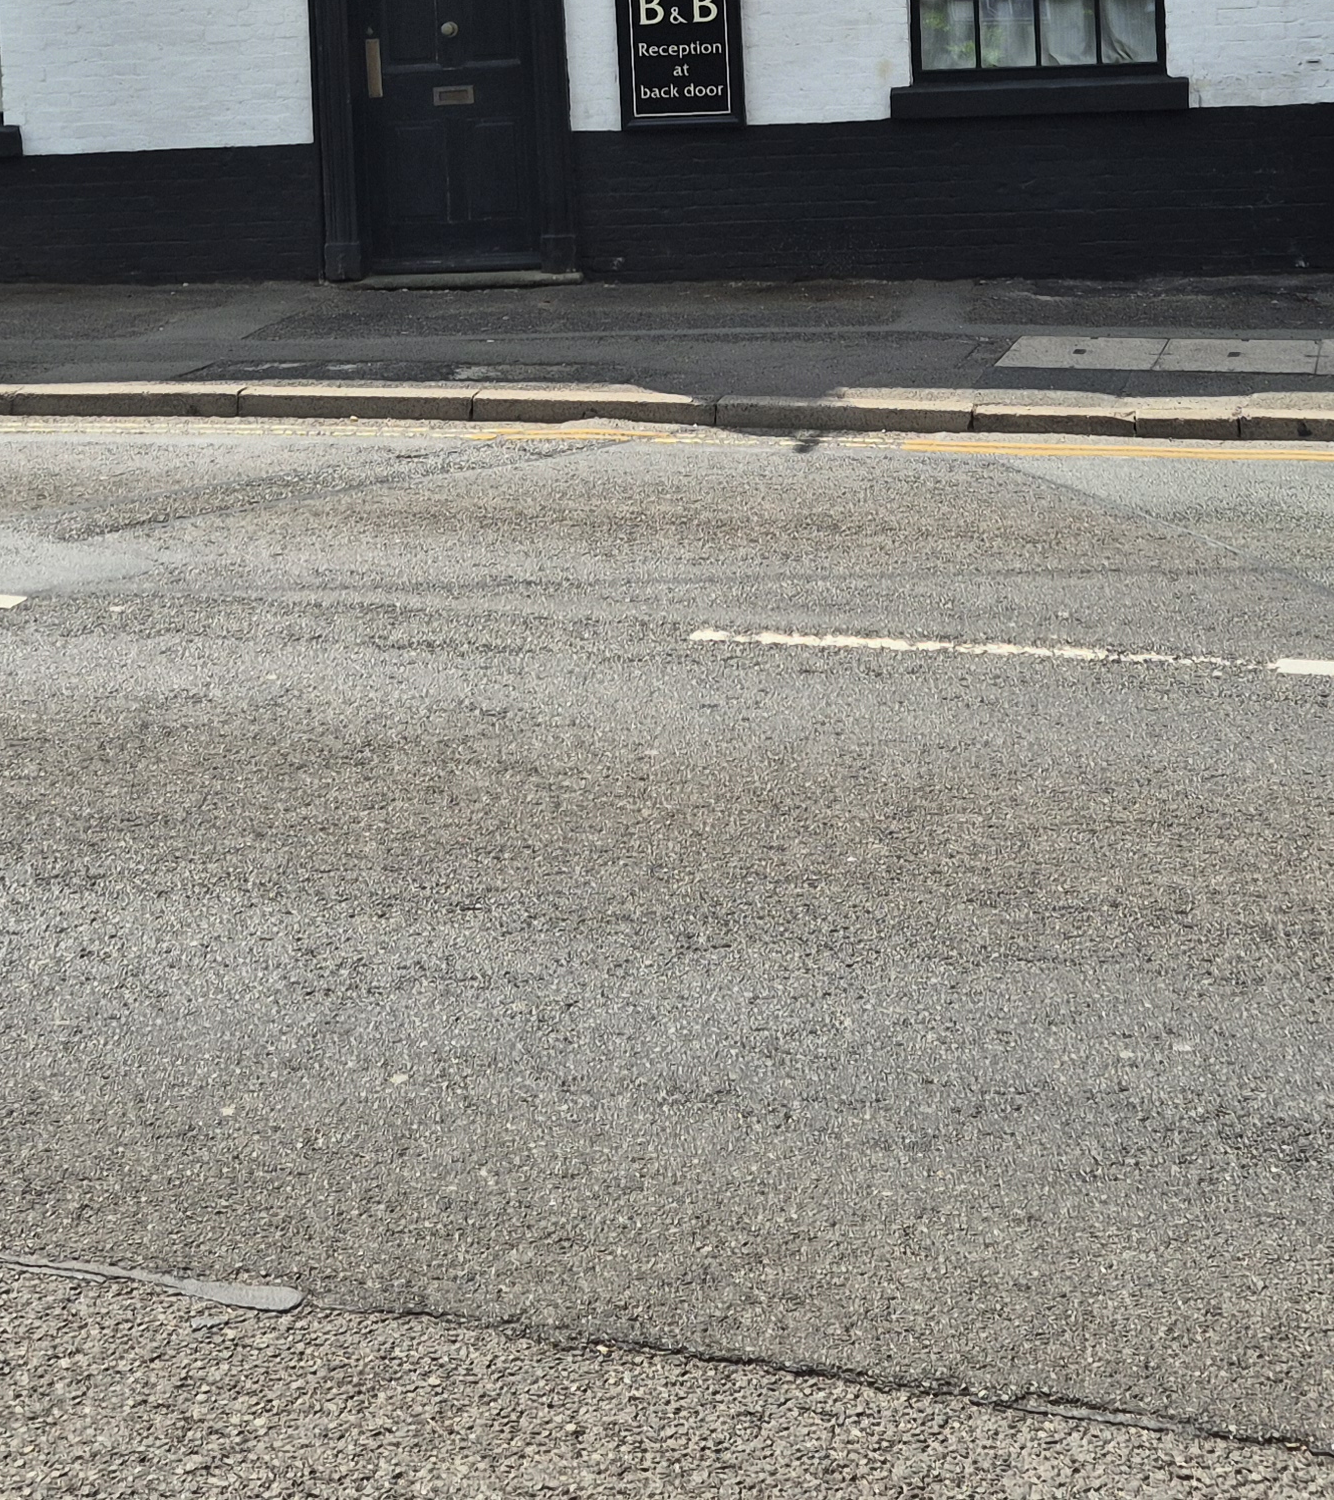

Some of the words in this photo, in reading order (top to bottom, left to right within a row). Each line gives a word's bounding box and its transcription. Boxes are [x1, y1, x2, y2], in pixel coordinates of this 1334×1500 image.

[638, 41, 722, 59] Reception
[673, 63, 690, 77] at
[640, 82, 680, 99] back
[684, 82, 724, 97] door
